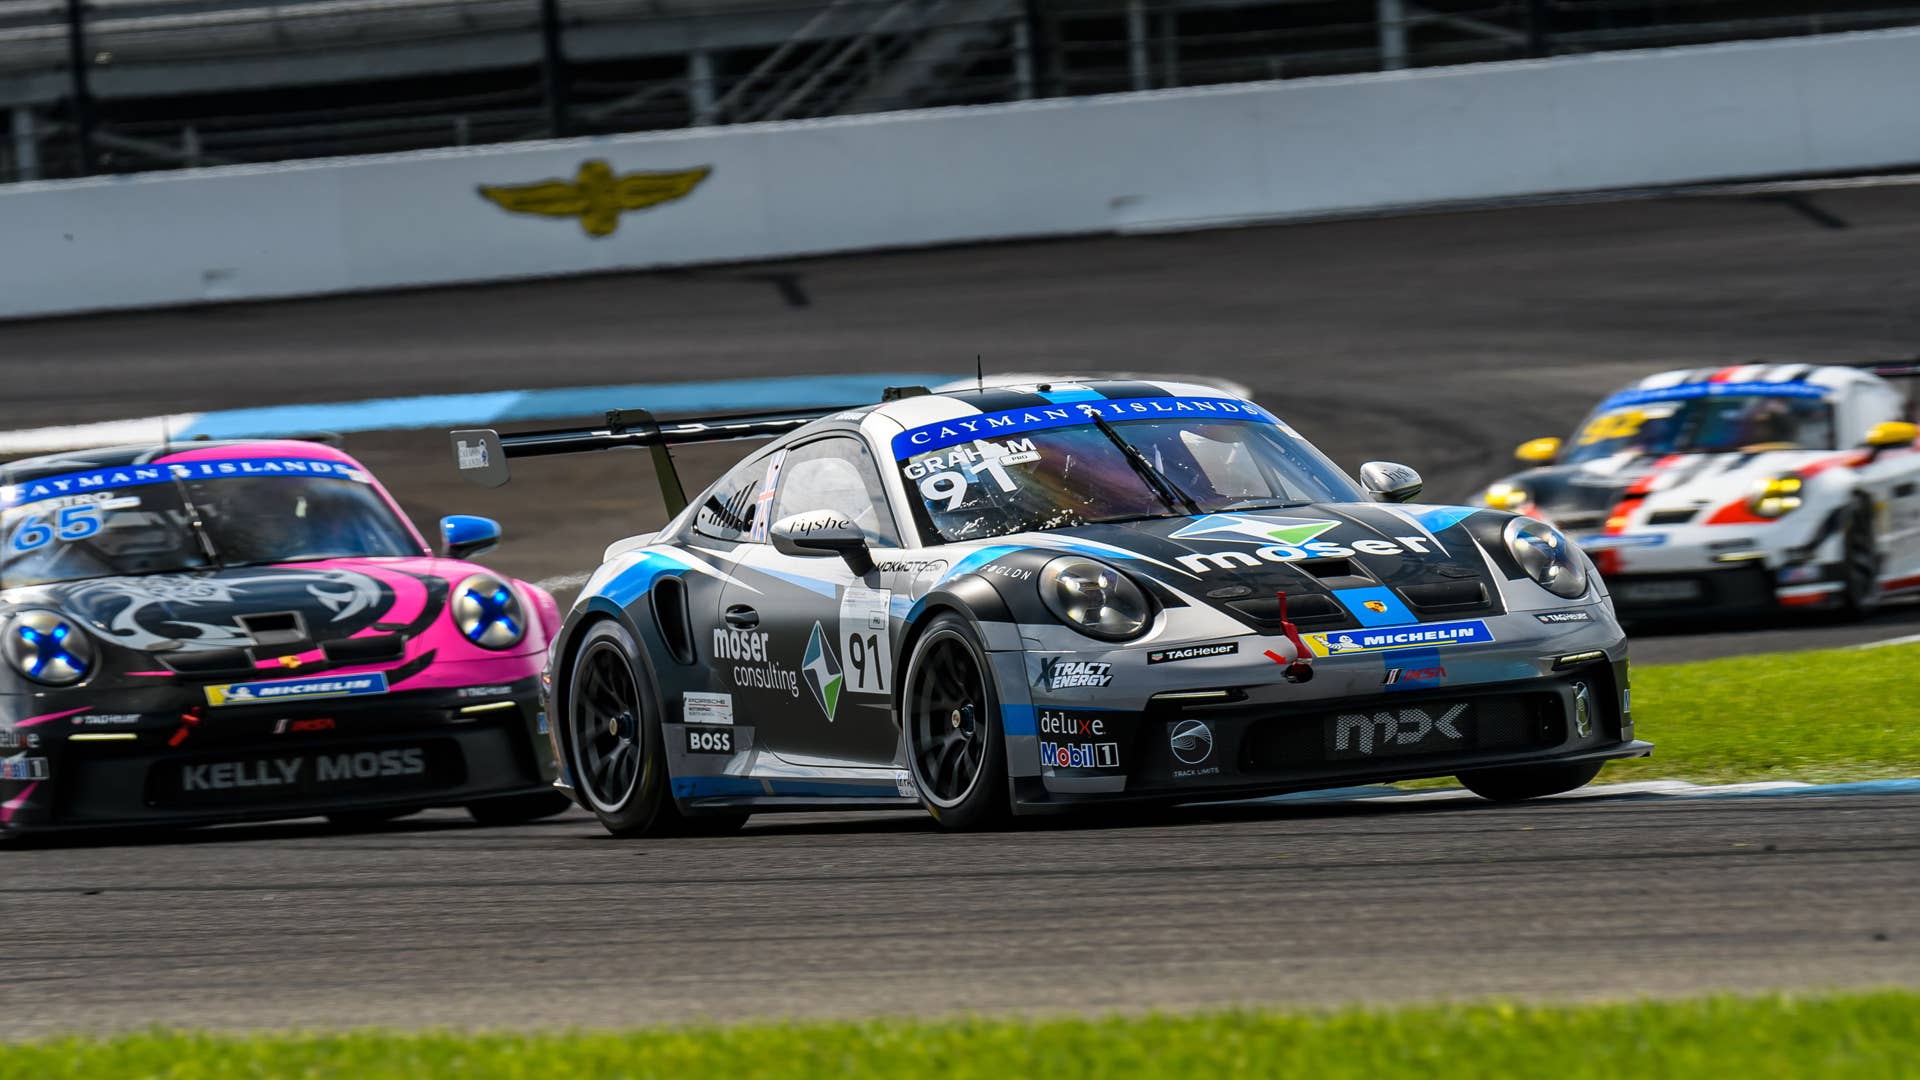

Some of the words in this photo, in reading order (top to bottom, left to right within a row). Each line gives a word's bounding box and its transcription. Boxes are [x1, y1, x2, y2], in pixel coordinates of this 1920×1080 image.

[911, 408, 1066, 445] CAYMAN
[1113, 400, 1259, 416] ISLANDS
[200, 461, 351, 477] ISLANDS
[920, 460, 1018, 512] 91
[14, 506, 101, 552] 65
[1175, 534, 1430, 573] moser
[713, 628, 769, 663] moser
[1363, 627, 1475, 646] MICHELIN
[849, 632, 884, 690] 91
[258, 680, 372, 696] MICHELIN
[734, 662, 800, 698] consulting
[1051, 674, 1112, 689] ENERGY
[1041, 711, 1104, 736] deluxe
[690, 732, 730, 750] BOSS
[1041, 742, 1095, 768] Mobil
[182, 757, 304, 791] KELLY
[316, 748, 425, 782] MOSS
[1173, 769, 1197, 777] TRACK
